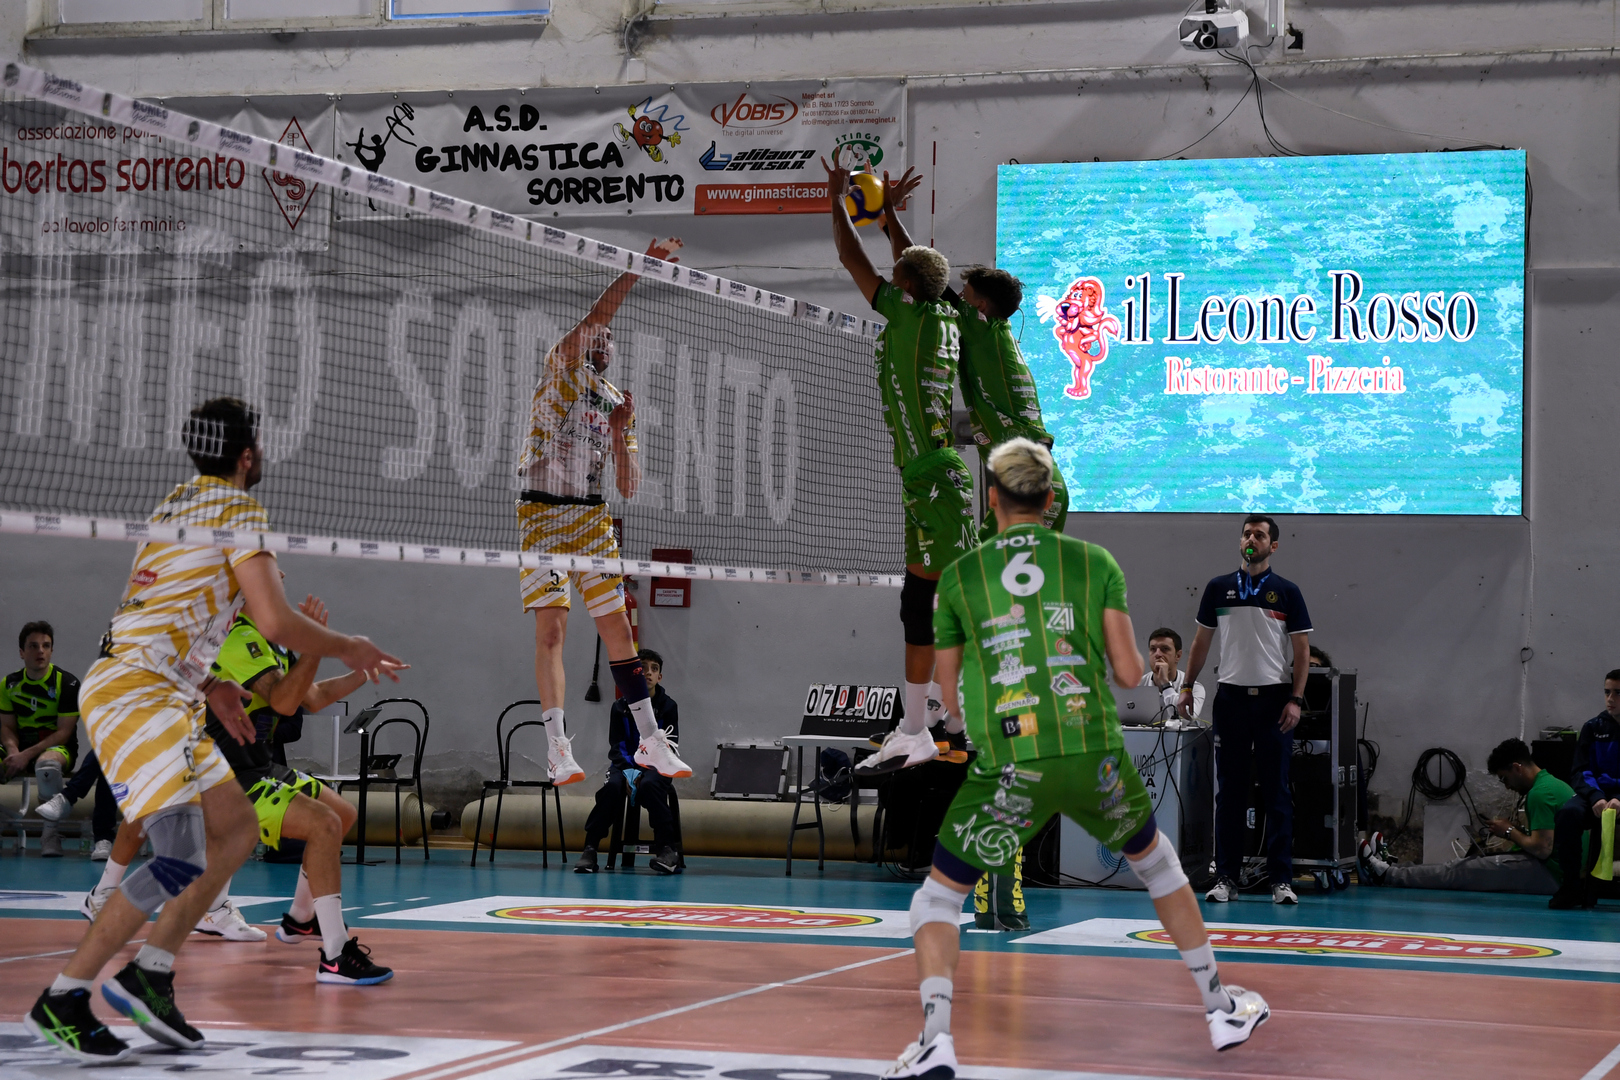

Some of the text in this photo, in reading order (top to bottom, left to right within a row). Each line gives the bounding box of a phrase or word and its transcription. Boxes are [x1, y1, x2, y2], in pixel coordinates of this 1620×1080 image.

[802, 92, 825, 100] Meginet
[133, 100, 168, 120] ROMEO
[464, 105, 547, 132] A.S.D.
[722, 93, 786, 128] VOBIS
[18, 121, 117, 140] associazione
[849, 117, 896, 125] www.meginet.it
[734, 129, 756, 138] digital
[836, 132, 881, 144] STINGA
[415, 142, 624, 172] GINNASTICA
[116, 153, 246, 192] sorrento
[527, 174, 684, 205] SORRENTO
[42, 215, 186, 236] palavolo femminie
[1121, 271, 1478, 343] il Leone Rosso
[1164, 357, 1288, 394] Ristorante
[1307, 355, 1406, 393] Pizzeria
[995, 535, 1040, 549] POL
[924, 552, 930, 566] 8
[550, 570, 559, 586] 5
[1001, 552, 1045, 597] 6
[840, 690, 848, 706] 0
[857, 690, 865, 706] 0
[998, 697, 1037, 712] DIGENNARO
[520, 907, 843, 926] Del Monte
[1397, 944, 1518, 956] Del
